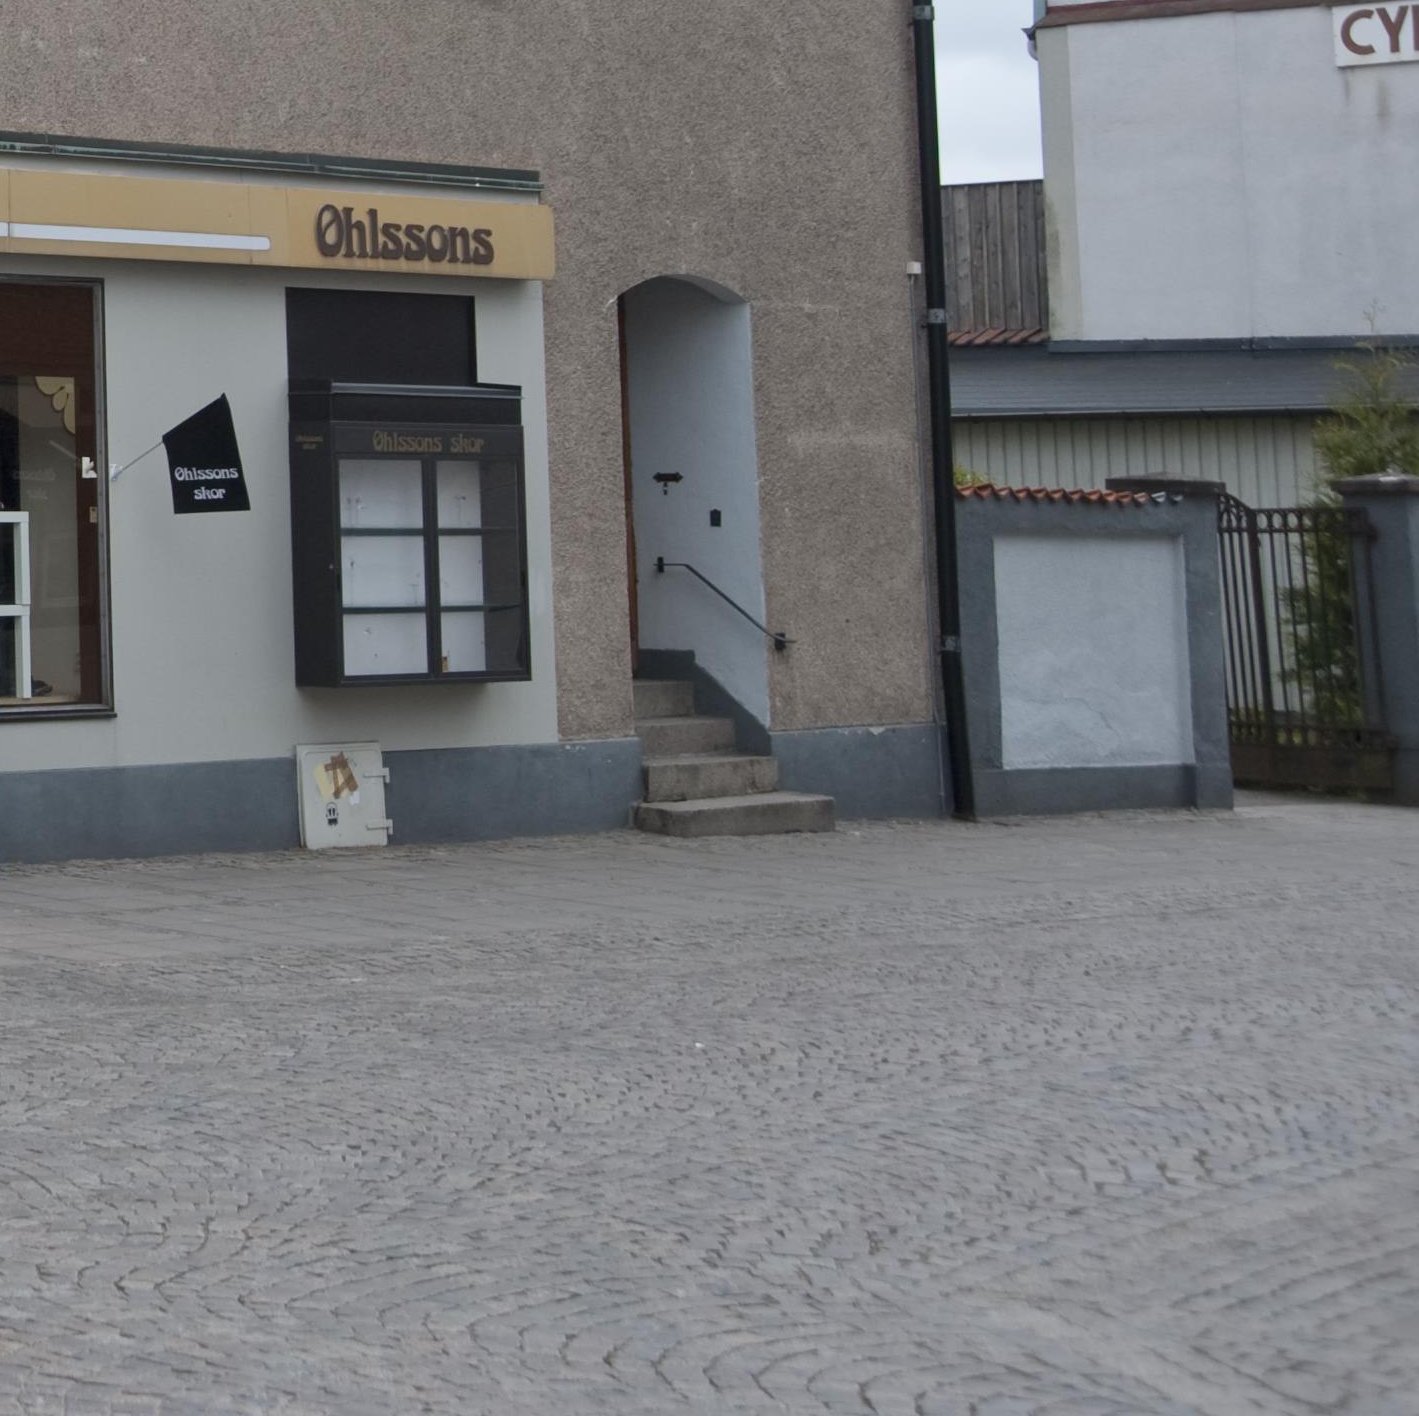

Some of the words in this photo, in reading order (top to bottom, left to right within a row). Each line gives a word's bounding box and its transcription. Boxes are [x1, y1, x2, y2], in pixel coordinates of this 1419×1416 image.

[1340, 5, 1419, 56] CY
[450, 433, 485, 453] skor
[194, 485, 226, 499] skor
